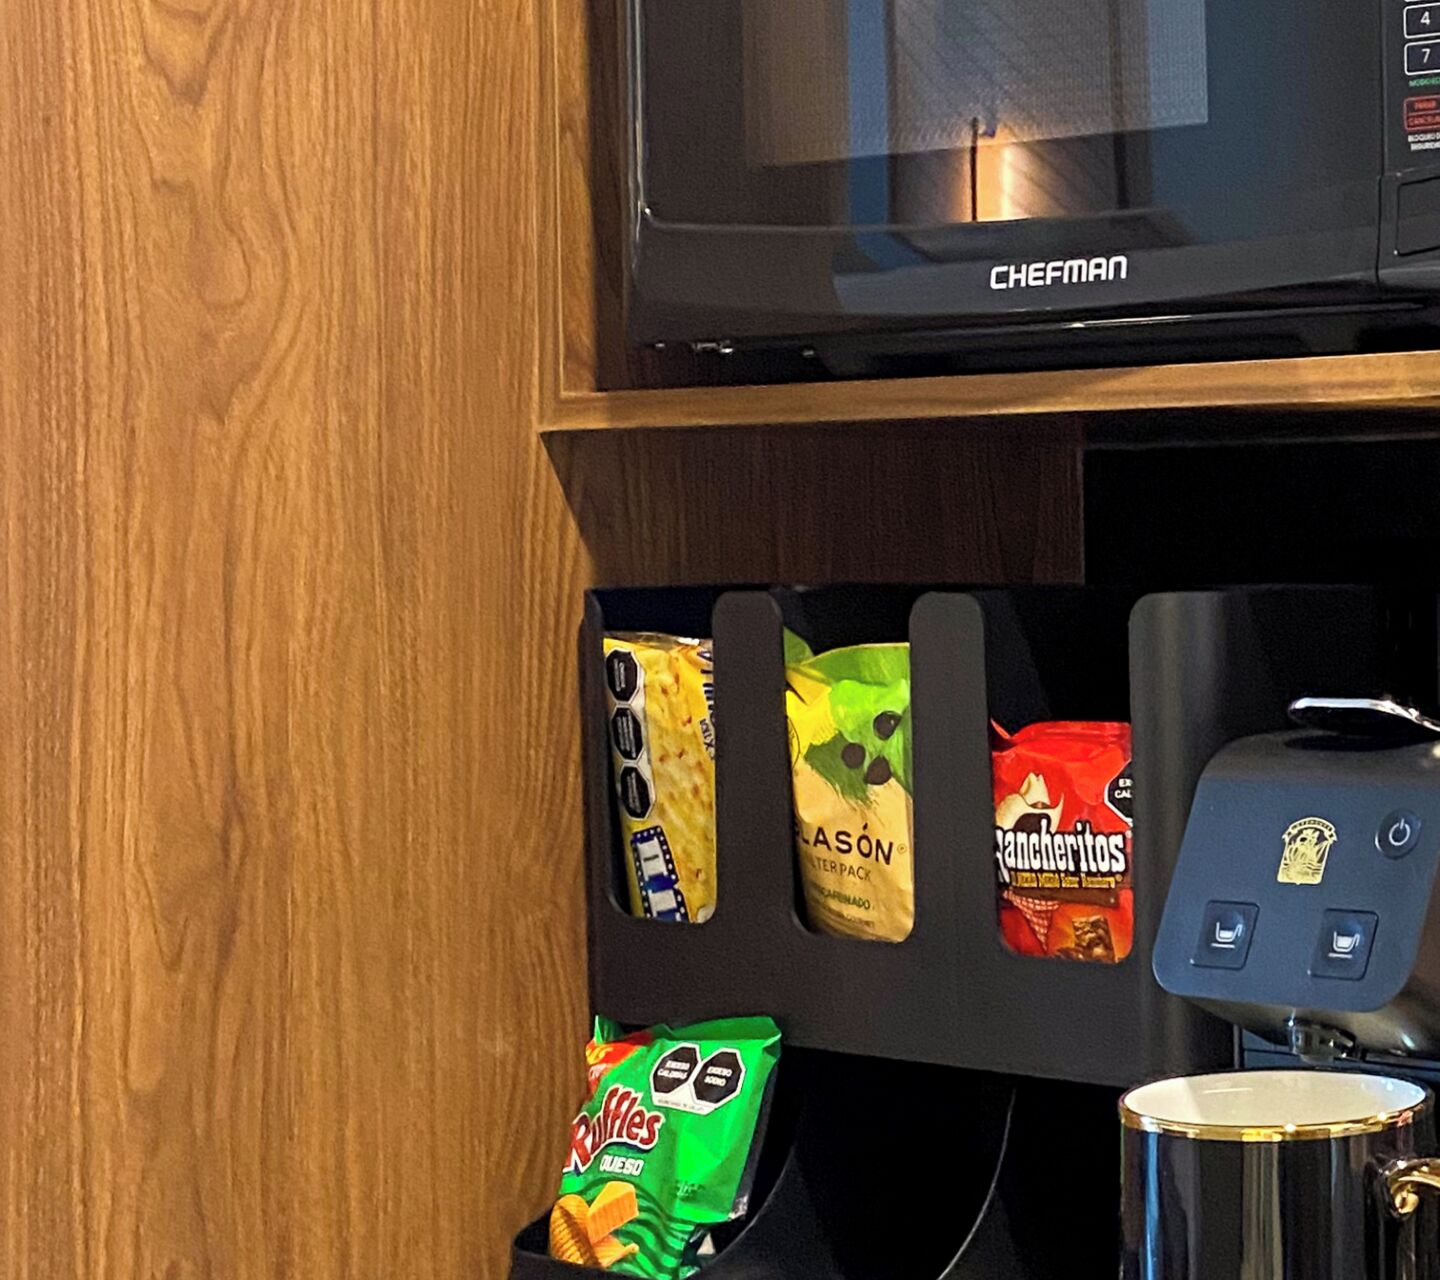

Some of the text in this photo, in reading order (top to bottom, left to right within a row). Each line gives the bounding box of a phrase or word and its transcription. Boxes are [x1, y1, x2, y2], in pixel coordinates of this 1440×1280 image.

[1420, 10, 1431, 26] 4
[1421, 48, 1432, 64] 7
[990, 255, 1128, 290] CHEFMAN
[563, 1084, 664, 1173] Ruffles
[600, 1154, 645, 1177] QUESO
